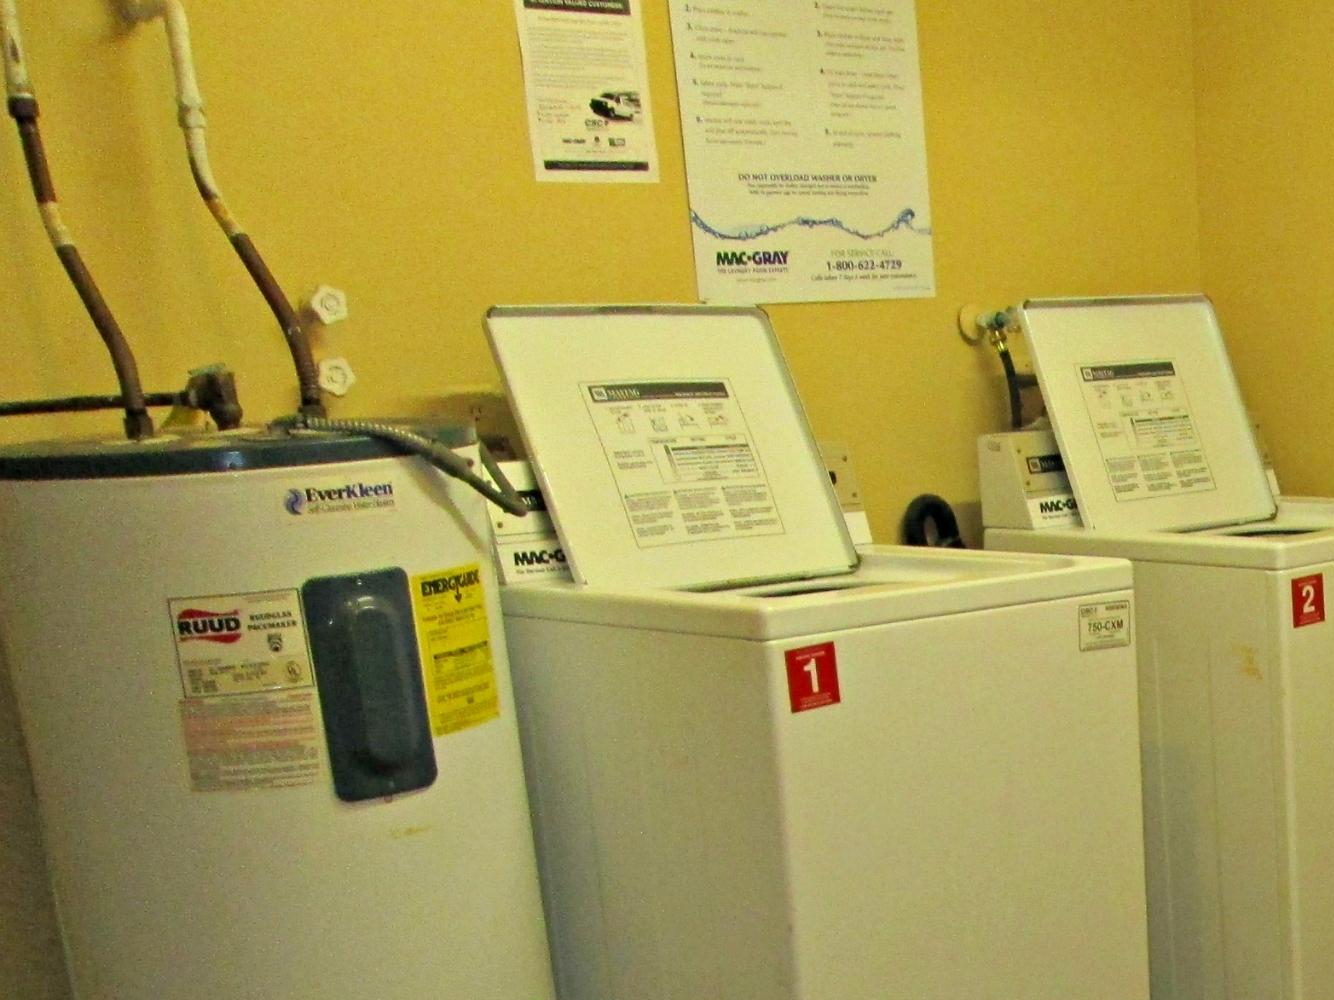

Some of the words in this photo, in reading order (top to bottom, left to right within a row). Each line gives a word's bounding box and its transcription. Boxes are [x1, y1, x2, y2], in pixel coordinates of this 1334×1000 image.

[738, 173, 751, 181] DO
[811, 174, 841, 182] WASHER
[827, 259, 902, 271] 1-800-622-4729
[305, 481, 393, 502] EverKleen
[1302, 585, 1315, 614] 2
[177, 617, 241, 636] RUUD
[803, 658, 819, 693] 1
